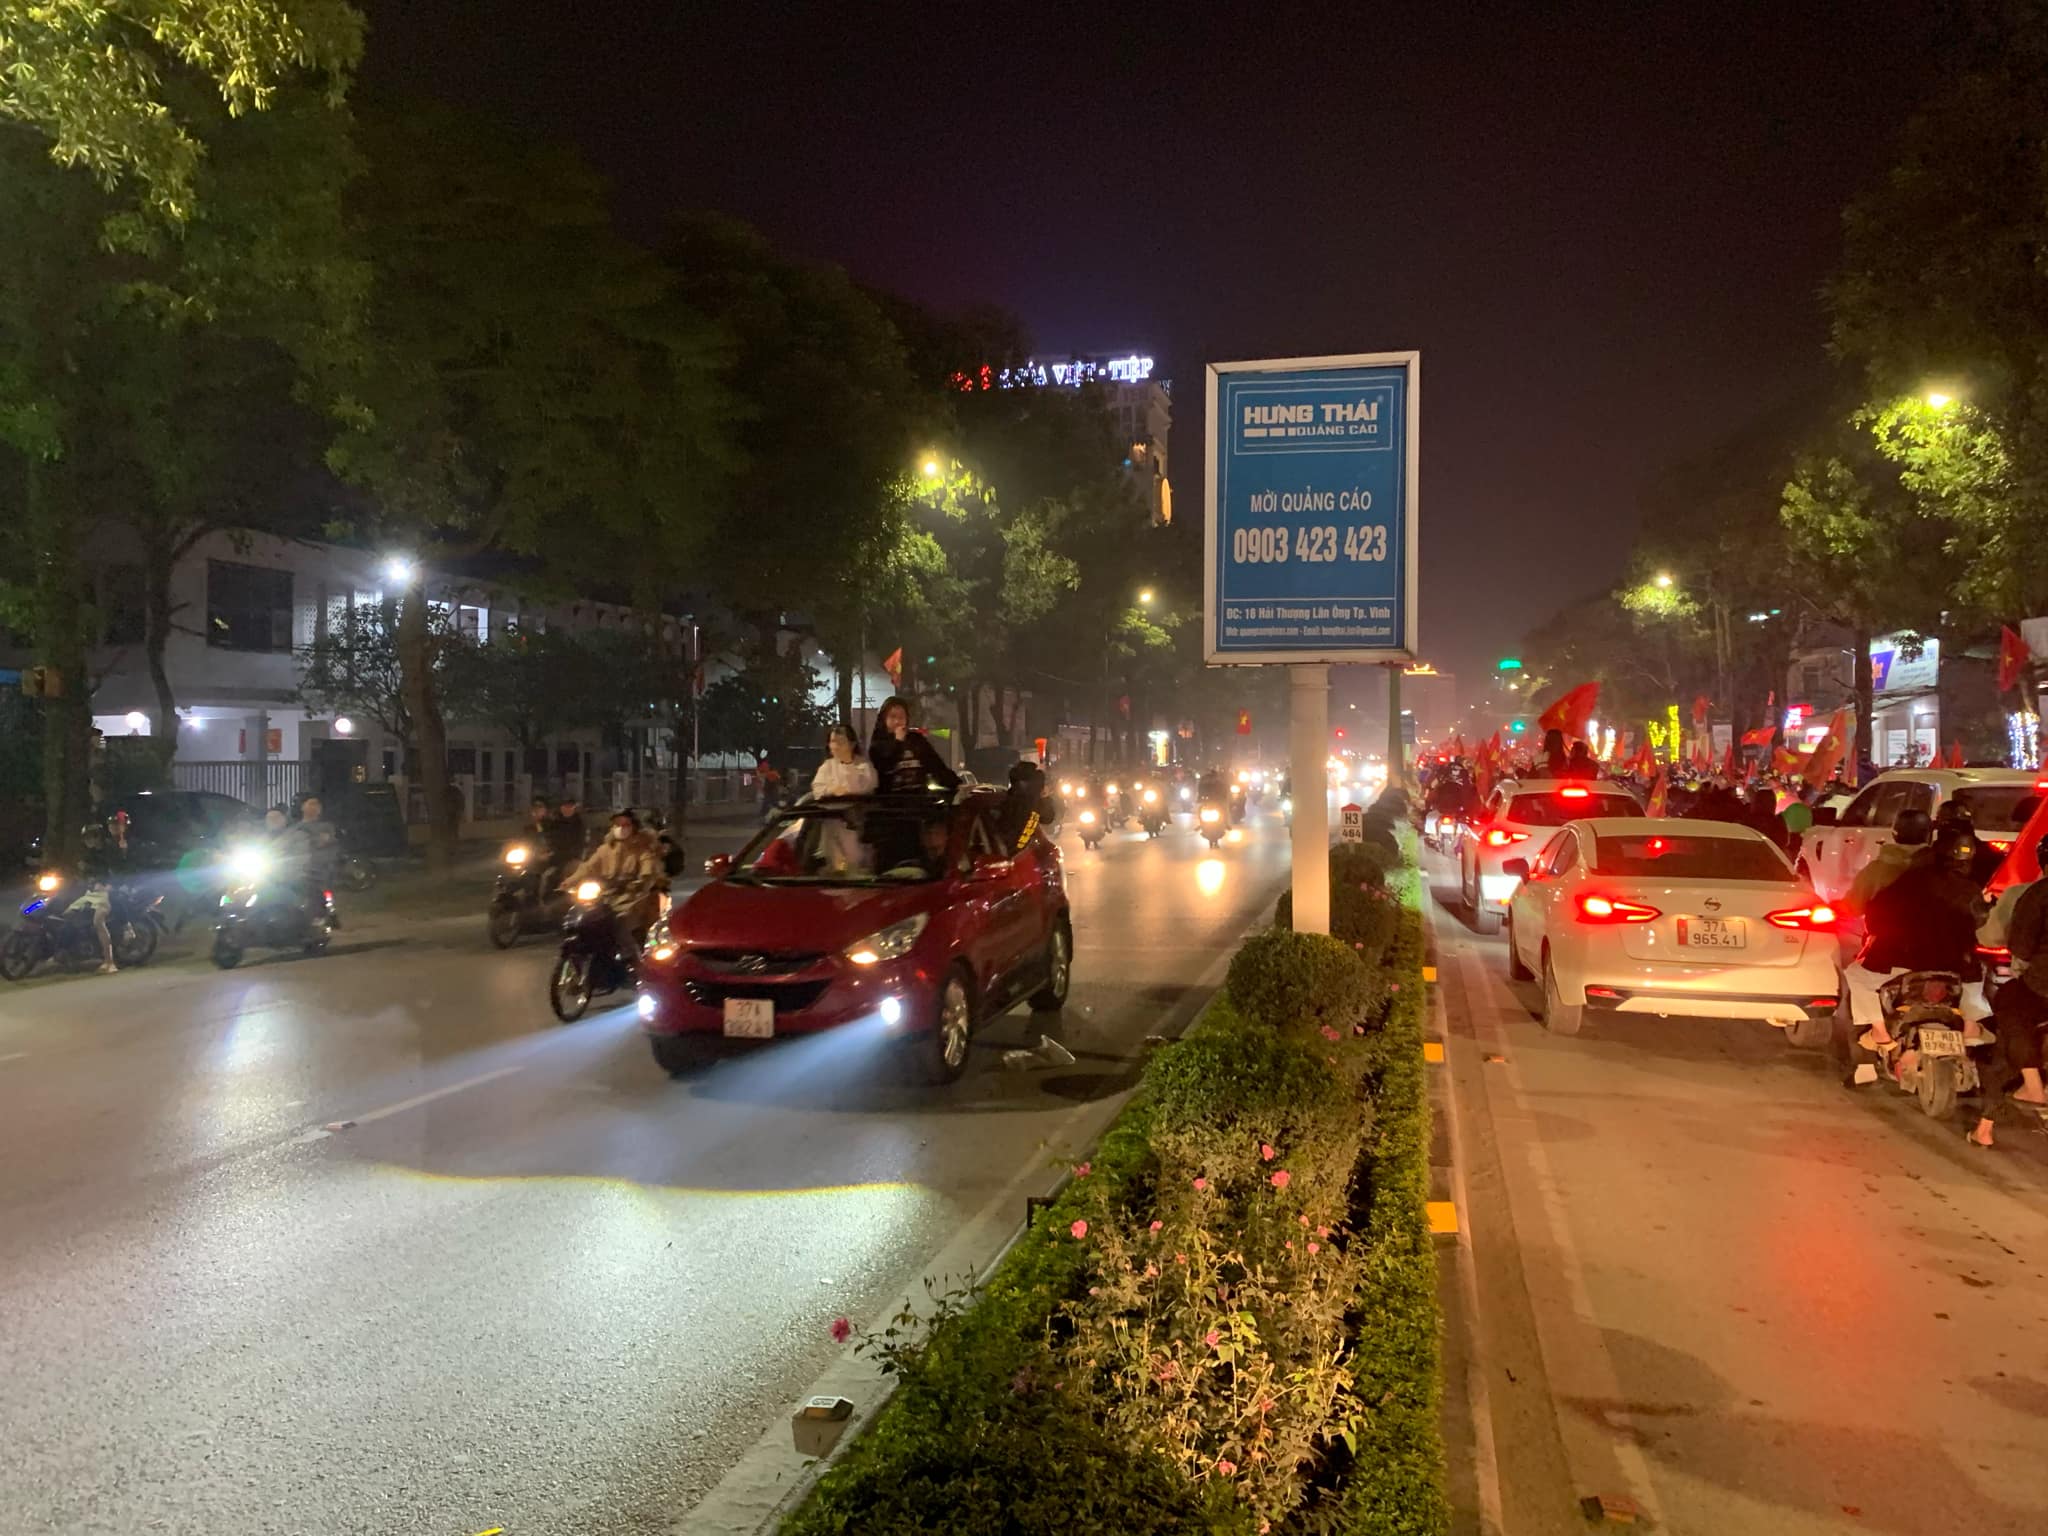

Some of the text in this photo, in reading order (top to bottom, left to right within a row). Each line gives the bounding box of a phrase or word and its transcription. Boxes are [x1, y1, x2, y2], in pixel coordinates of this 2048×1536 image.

[1321, 399, 1378, 422] THÁI
[1251, 485, 1372, 512] MỜI QUẢNG CÁO
[1234, 525, 1387, 563] 0903 423 423
[1370, 606, 1390, 618] Vinh
[1344, 812, 1359, 825] H3
[1704, 921, 1728, 933] 37A
[1693, 933, 1737, 946] 965.41
